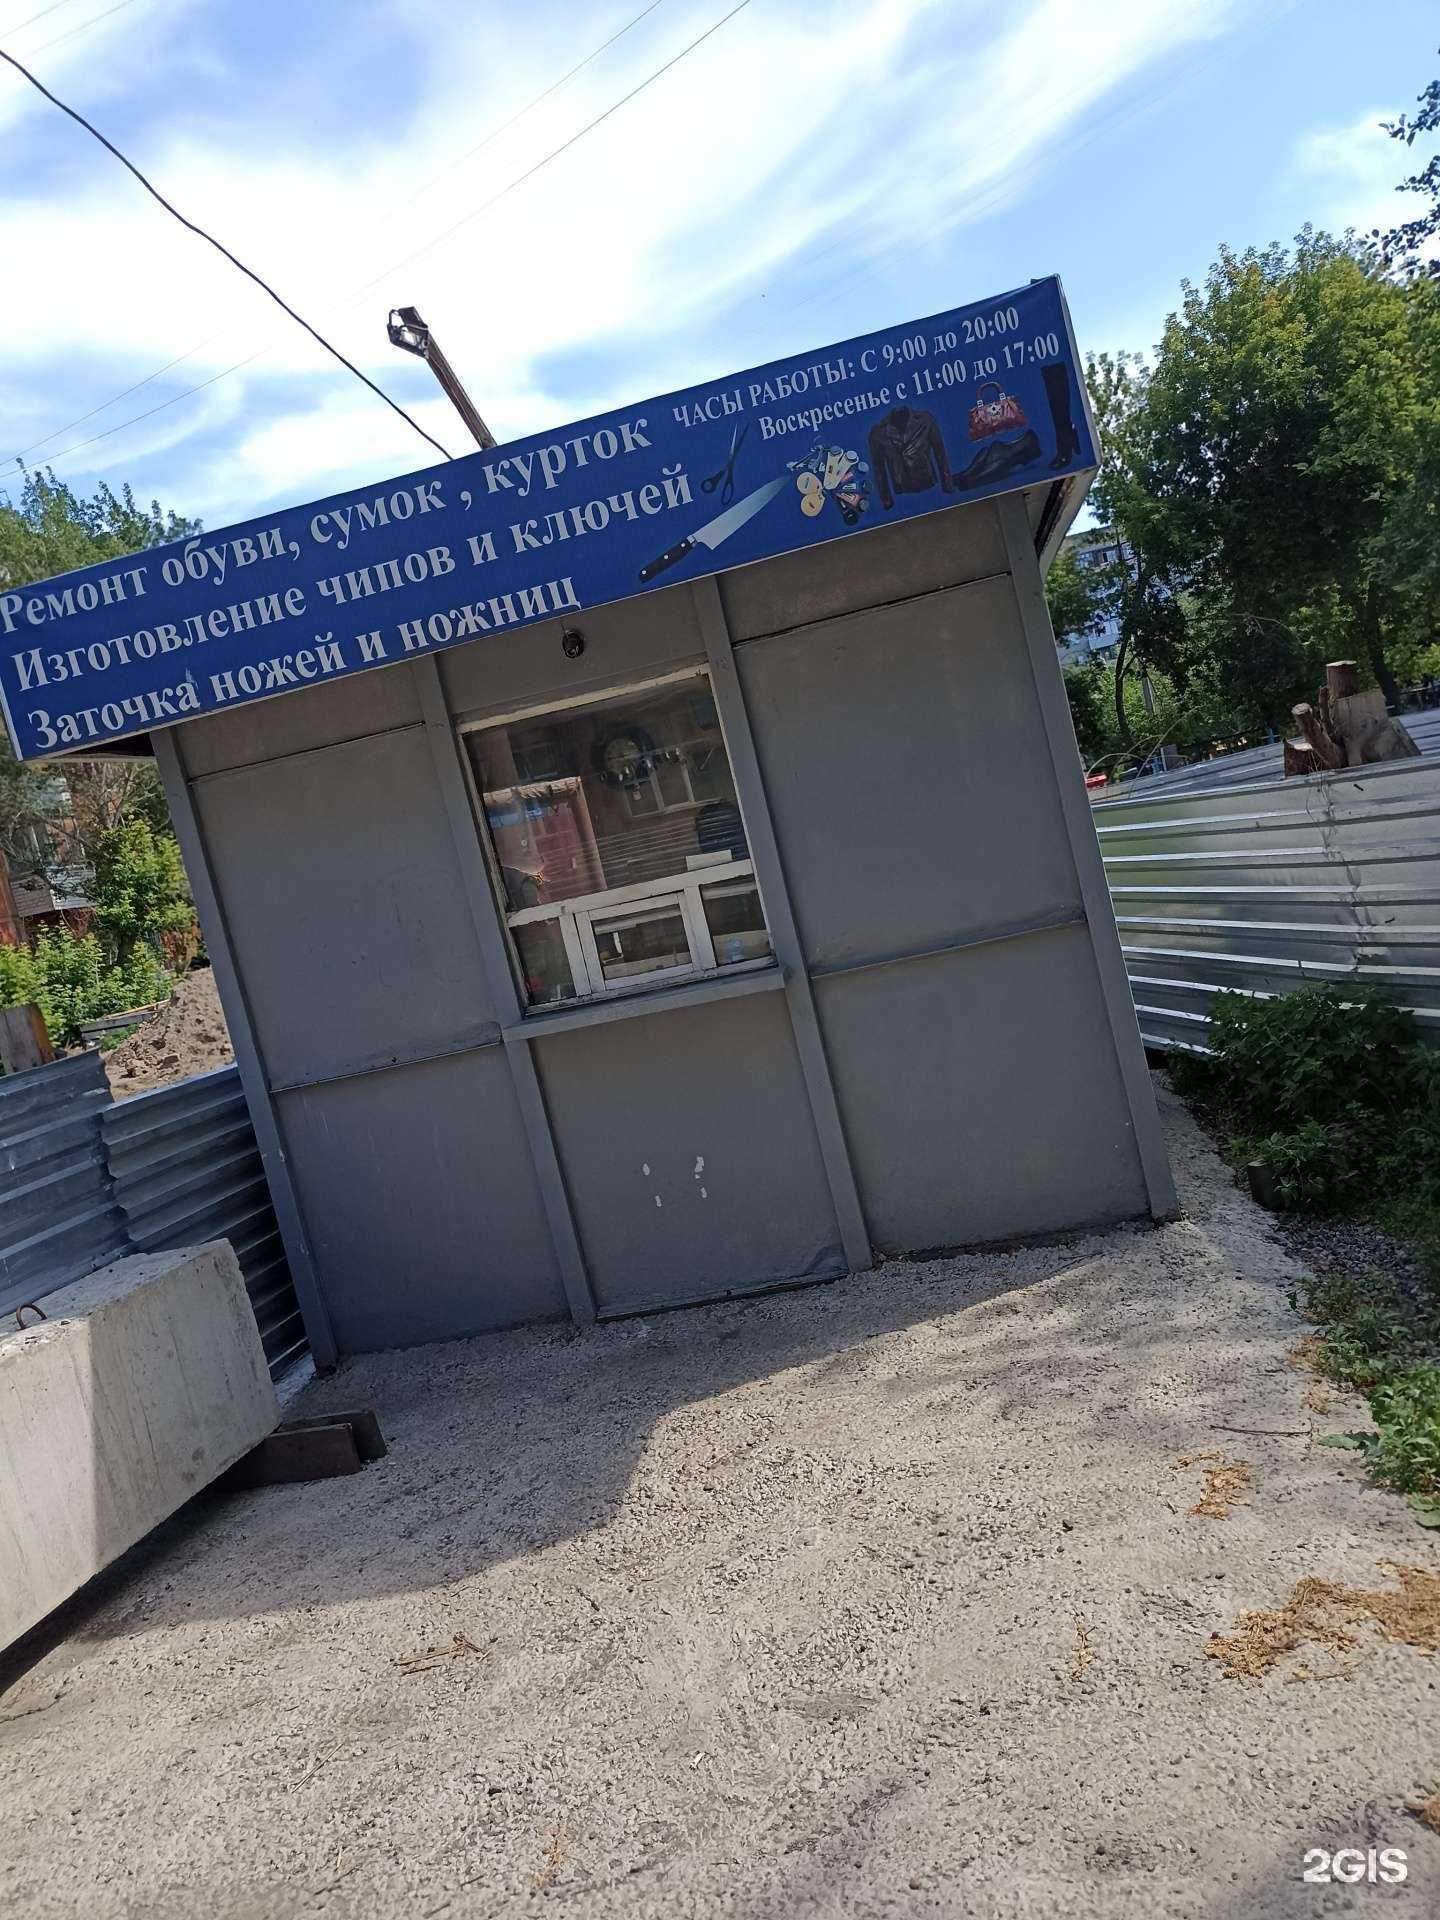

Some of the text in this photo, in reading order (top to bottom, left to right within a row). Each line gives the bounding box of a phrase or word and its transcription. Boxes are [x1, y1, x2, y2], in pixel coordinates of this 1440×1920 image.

[672, 388, 744, 428] ЧАСЫ
[748, 358, 856, 408] РАБОТЫ:
[882, 335, 927, 369] 9:00
[933, 332, 957, 355] до
[961, 306, 1020, 345] 20:00
[758, 333, 1060, 441] Воскресенье с 11:00 до 17:00
[0, 566, 148, 634] Ремонт
[161, 526, 300, 586] обуви,
[310, 480, 447, 550] сумок
[482, 418, 652, 497] курток
[11, 463, 694, 693] Изготовление чипов и ключей
[27, 576, 582, 749] Заточка ножей и ножниц
